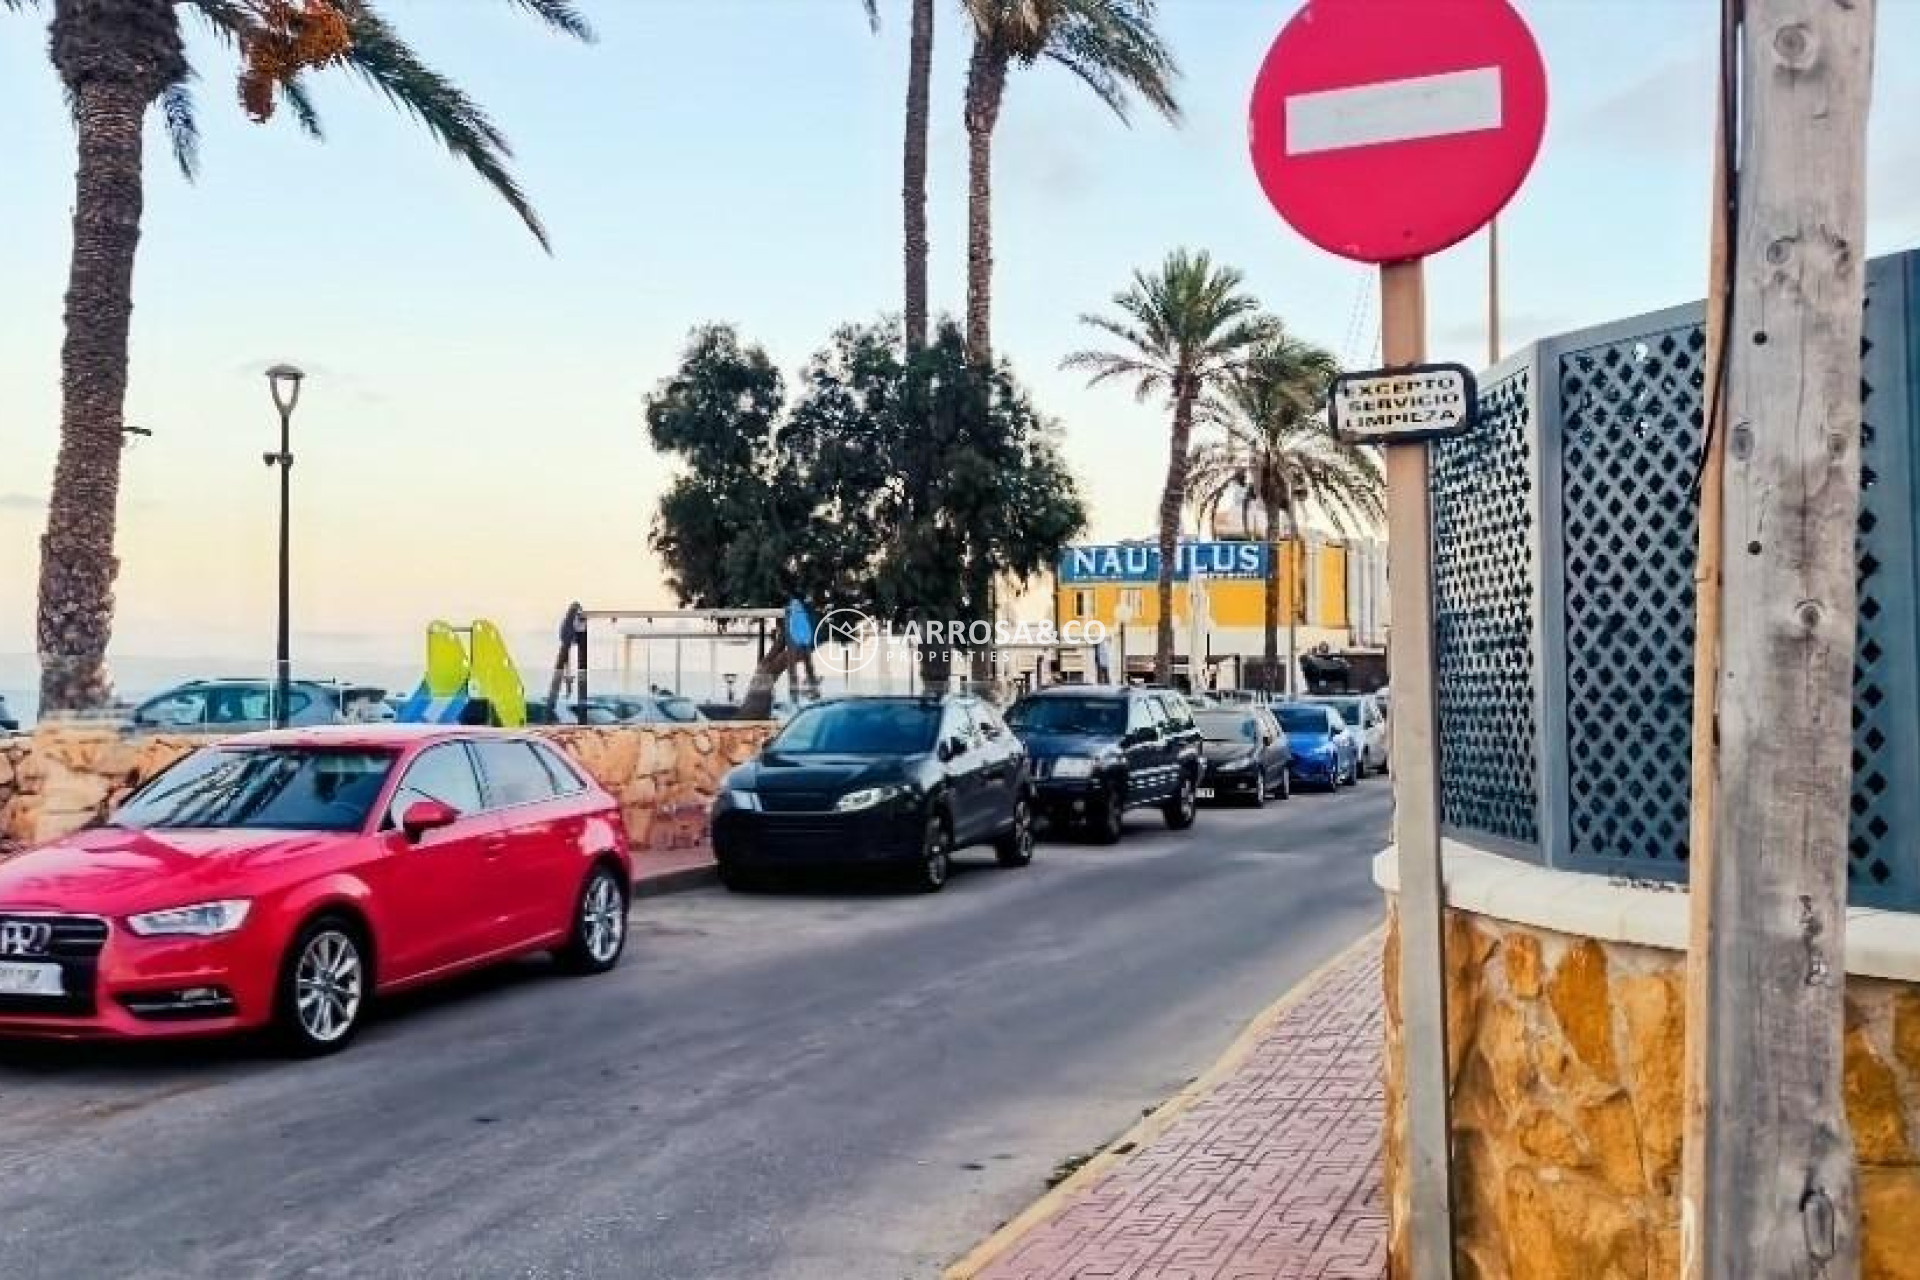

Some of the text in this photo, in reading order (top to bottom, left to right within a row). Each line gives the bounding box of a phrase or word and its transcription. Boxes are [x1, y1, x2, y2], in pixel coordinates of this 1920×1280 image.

[1342, 378, 1455, 397] EXCEPTO
[1347, 394, 1460, 412] SERVICIO
[1345, 409, 1455, 428] LIMPIEZA
